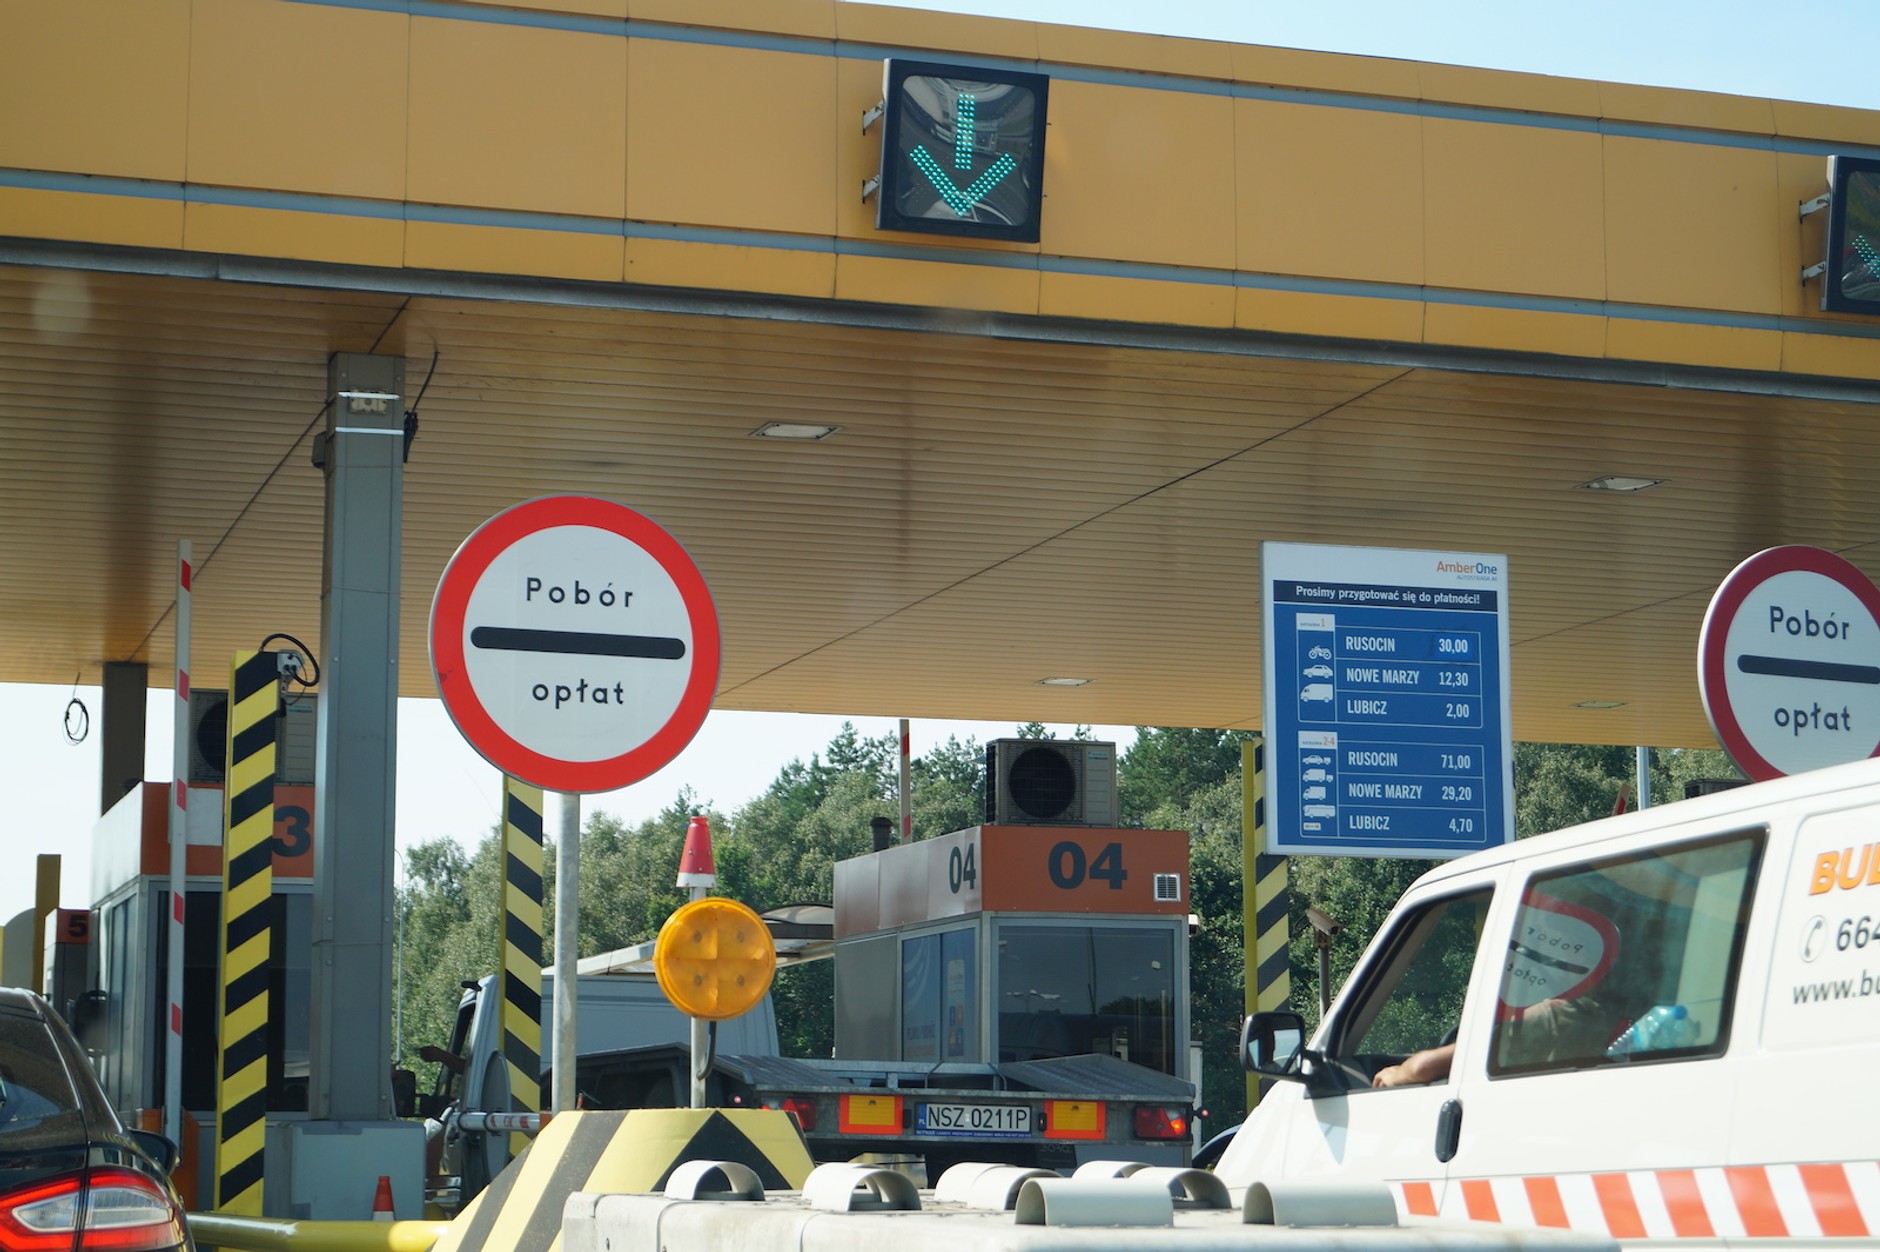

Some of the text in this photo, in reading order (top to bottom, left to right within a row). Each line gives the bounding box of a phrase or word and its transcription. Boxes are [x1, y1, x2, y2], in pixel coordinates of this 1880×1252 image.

[1436, 560, 1498, 575] AmberOne
[526, 577, 633, 608] Pobór
[1296, 585, 1480, 604] Prosimy przygotować się do płatności!
[1769, 605, 1850, 640] Pobór
[1345, 636, 1469, 654] RUSOCIN 30,00
[1346, 667, 1469, 687] NOWE MARZY 12,30
[532, 678, 624, 709] opłat
[1347, 699, 1470, 719] LUBICZ 2,00
[1774, 702, 1851, 737] opłat
[1348, 751, 1471, 770] RUSOCIN 71,00
[1348, 783, 1472, 802] NOWE MARZY 29,20
[1349, 814, 1473, 834] LUBICZ 4,70
[949, 842, 977, 894] 04
[1048, 840, 1128, 890] 04
[928, 1106, 965, 1128] NSZ
[971, 1108, 1027, 1129] 0211P
